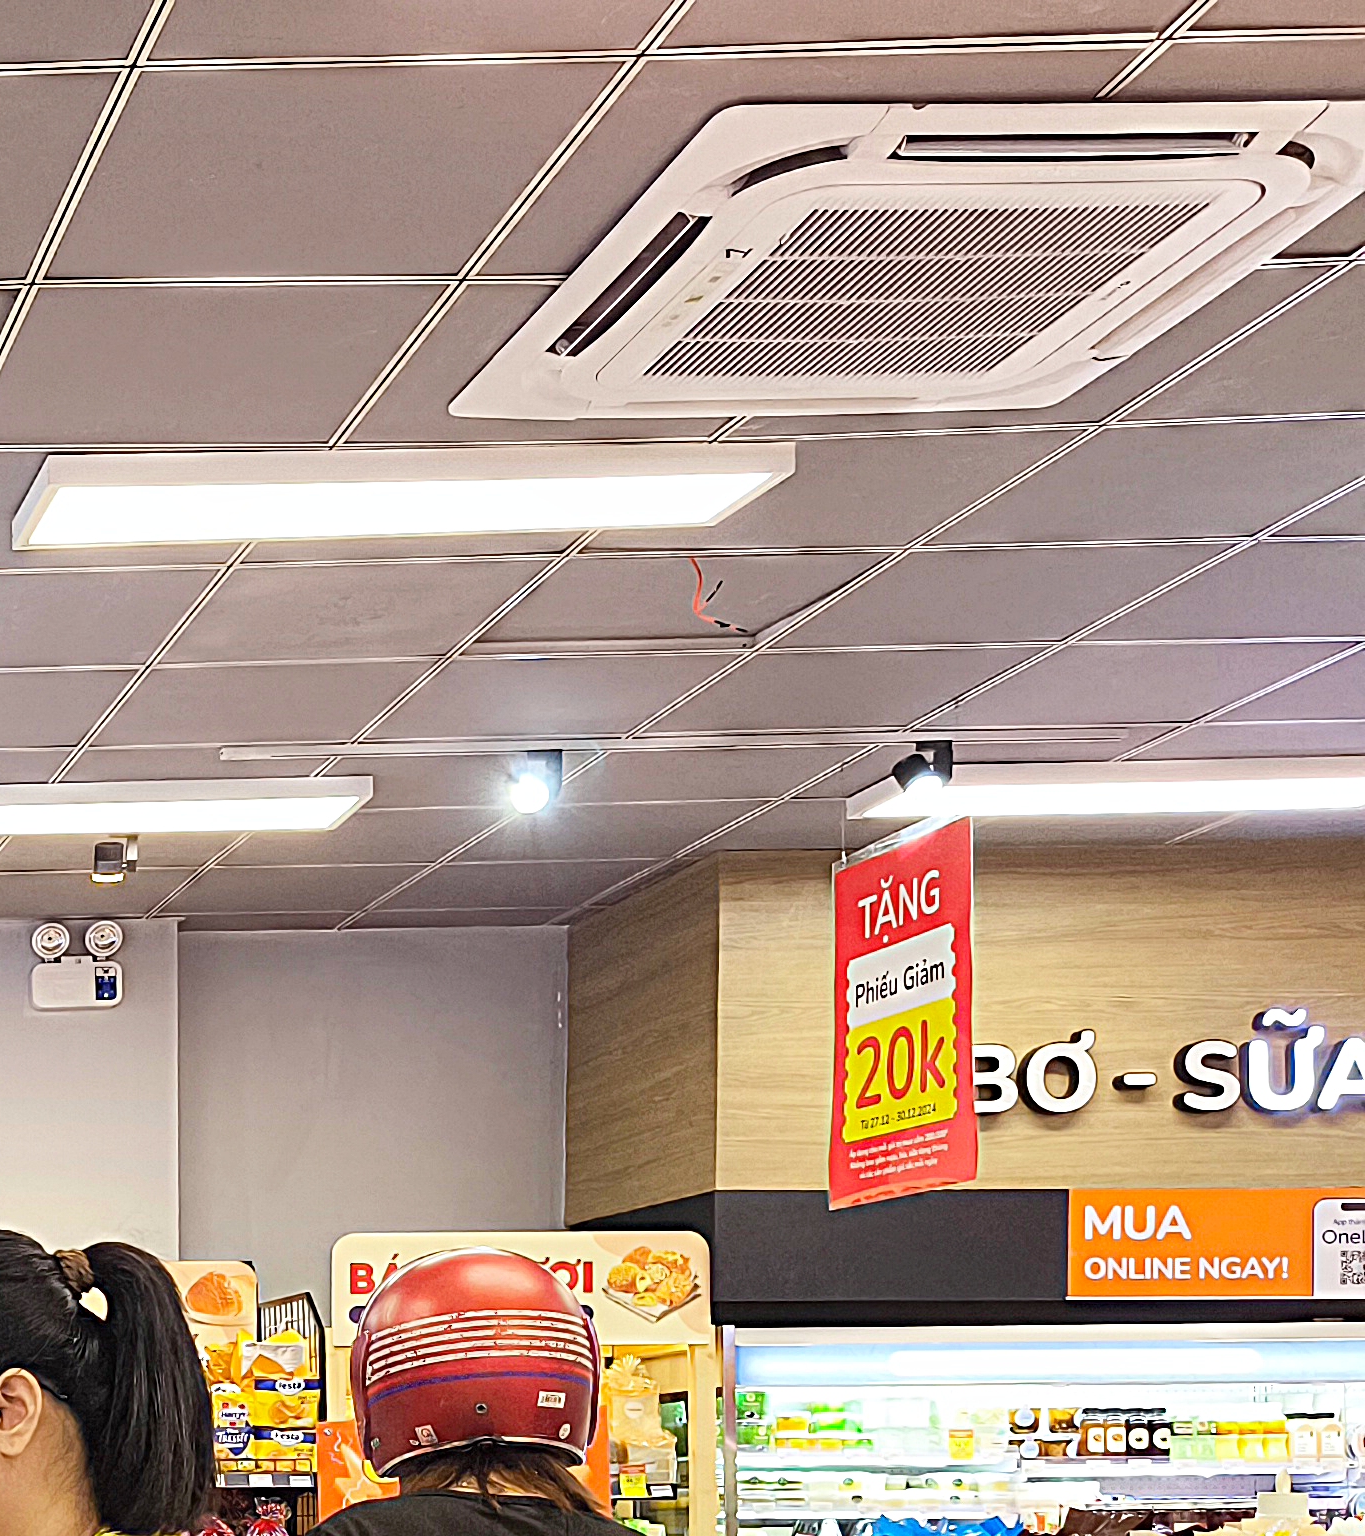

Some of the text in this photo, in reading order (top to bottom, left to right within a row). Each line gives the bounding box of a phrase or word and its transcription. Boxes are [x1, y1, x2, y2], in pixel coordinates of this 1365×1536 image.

[857, 869, 940, 944] TẶNG
[855, 959, 945, 1008] Phiếu Giảm
[856, 1020, 946, 1109] 20k
[973, 1028, 1097, 1114] BƠ
[1083, 1205, 1192, 1241] MUA
[1083, 1255, 1289, 1281] ONLINE NGAY!
